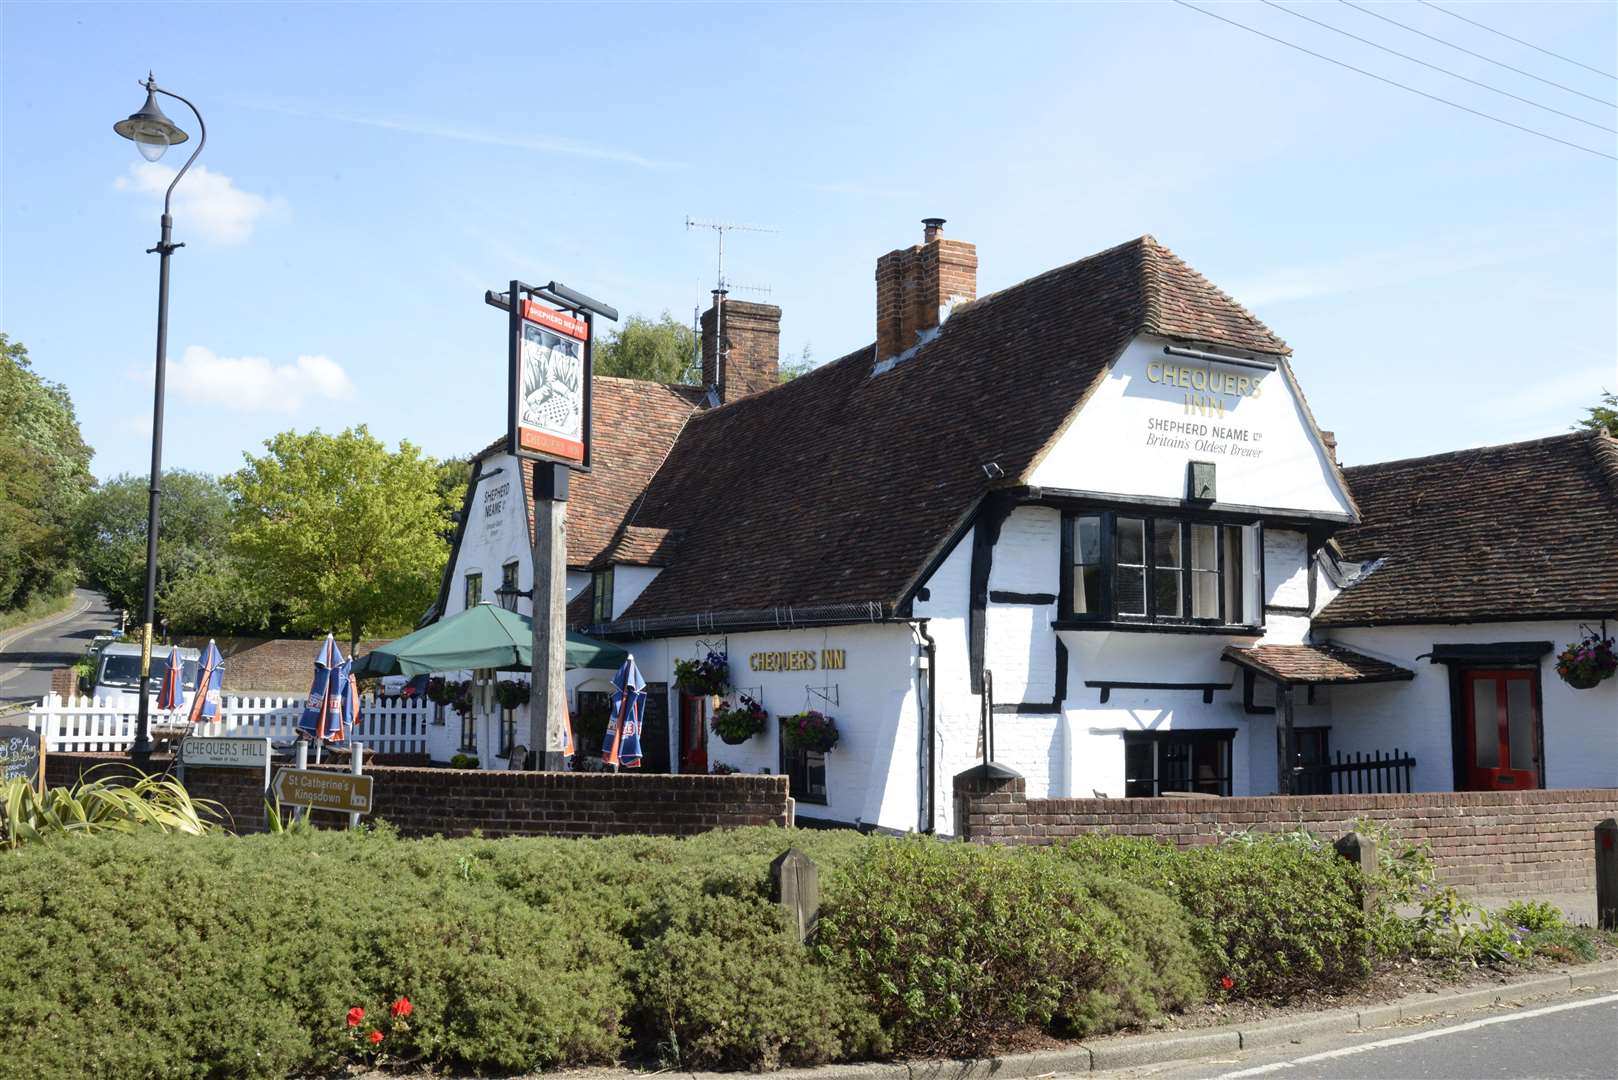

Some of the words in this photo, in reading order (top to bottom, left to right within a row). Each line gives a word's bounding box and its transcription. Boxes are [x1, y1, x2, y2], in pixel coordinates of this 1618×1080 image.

[530, 307, 563, 325] SHEPHERD
[1147, 361, 1262, 399] CHEQUERS
[1184, 390, 1224, 419] INN
[1148, 418, 1208, 436] SHEPHERD
[1212, 426, 1249, 441] NEAME
[1147, 433, 1190, 449] Britain's
[1194, 439, 1227, 454] Oldest
[1230, 444, 1263, 458] Brewer
[485, 481, 510, 504] SHEPHERD
[486, 500, 502, 518] NEAME
[749, 650, 817, 672] CHEQUERS
[820, 649, 847, 670] INN
[185, 741, 238, 756] CHEQUERS
[241, 743, 265, 757] HILL
[288, 775, 299, 786] St
[301, 777, 350, 792] Catherine's
[294, 789, 341, 803] Kingsdown
